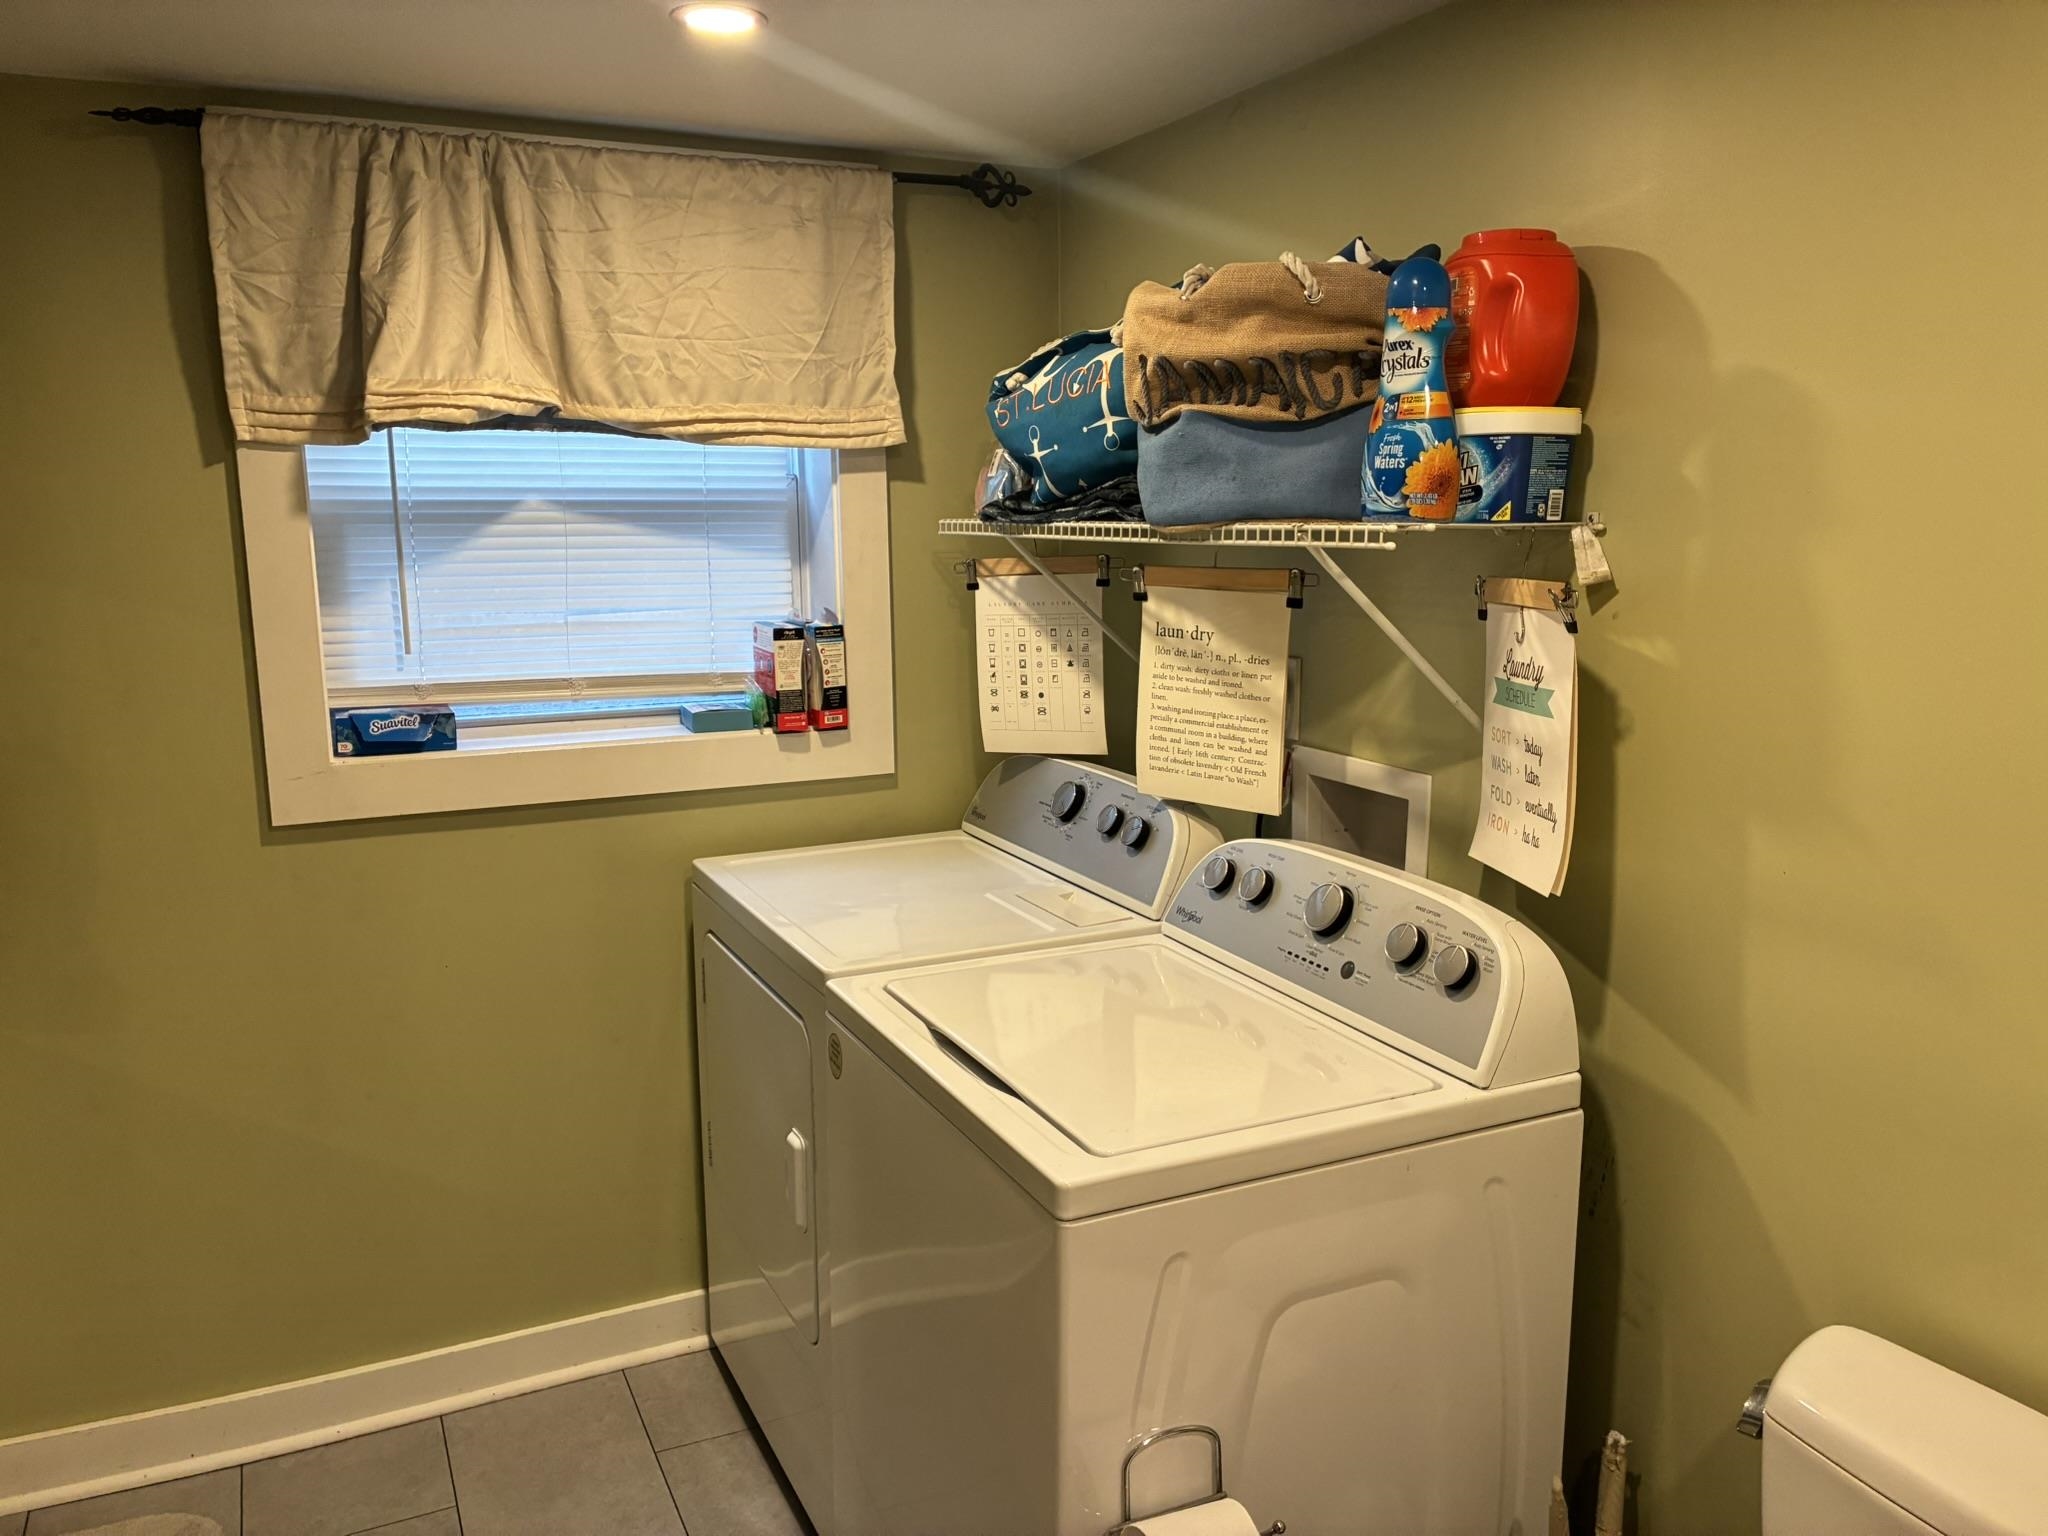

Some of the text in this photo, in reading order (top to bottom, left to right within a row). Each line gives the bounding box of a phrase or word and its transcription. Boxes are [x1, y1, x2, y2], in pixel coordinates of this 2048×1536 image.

[1378, 443, 1404, 457] Spring
[1374, 456, 1405, 469] Waters
[1244, 654, 1270, 665] -dries
[1152, 672, 1168, 680] aside
[1176, 674, 1184, 682] be
[1184, 676, 1206, 685] washed
[1241, 671, 1258, 679] linen
[1260, 674, 1272, 682] put
[1503, 648, 1544, 691] Laundry
[1158, 683, 1173, 691] clean
[1193, 687, 1212, 698] freshly
[1214, 690, 1237, 699] washed
[1238, 692, 1262, 702] clothes
[1505, 686, 1536, 708] SCHEDULE
[1157, 704, 1181, 715] washing
[1194, 709, 1216, 719] ironing
[371, 716, 418, 733] Suavitel
[1150, 714, 1173, 724] pecially
[1179, 718, 1214, 728] commercial
[1216, 723, 1259, 733] establishment
[1154, 725, 1186, 734] communal
[1248, 737, 1268, 745] where
[1177, 747, 1193, 758] Early
[1196, 750, 1208, 758] 16th
[1184, 738, 1200, 747] linen
[1228, 745, 1252, 754] washed
[1491, 726, 1511, 744] SORT
[1523, 734, 1543, 766] today
[1170, 757, 1195, 767] obsolete
[1230, 766, 1242, 774] Old
[1244, 767, 1266, 777] French
[1186, 769, 1202, 778] Latin
[1204, 772, 1224, 781] Lavare
[1491, 755, 1512, 775] WASH
[1524, 764, 1540, 787] later
[1490, 784, 1512, 806] FOLD
[1525, 798, 1557, 833] eventually
[1487, 811, 1510, 836] IRON
